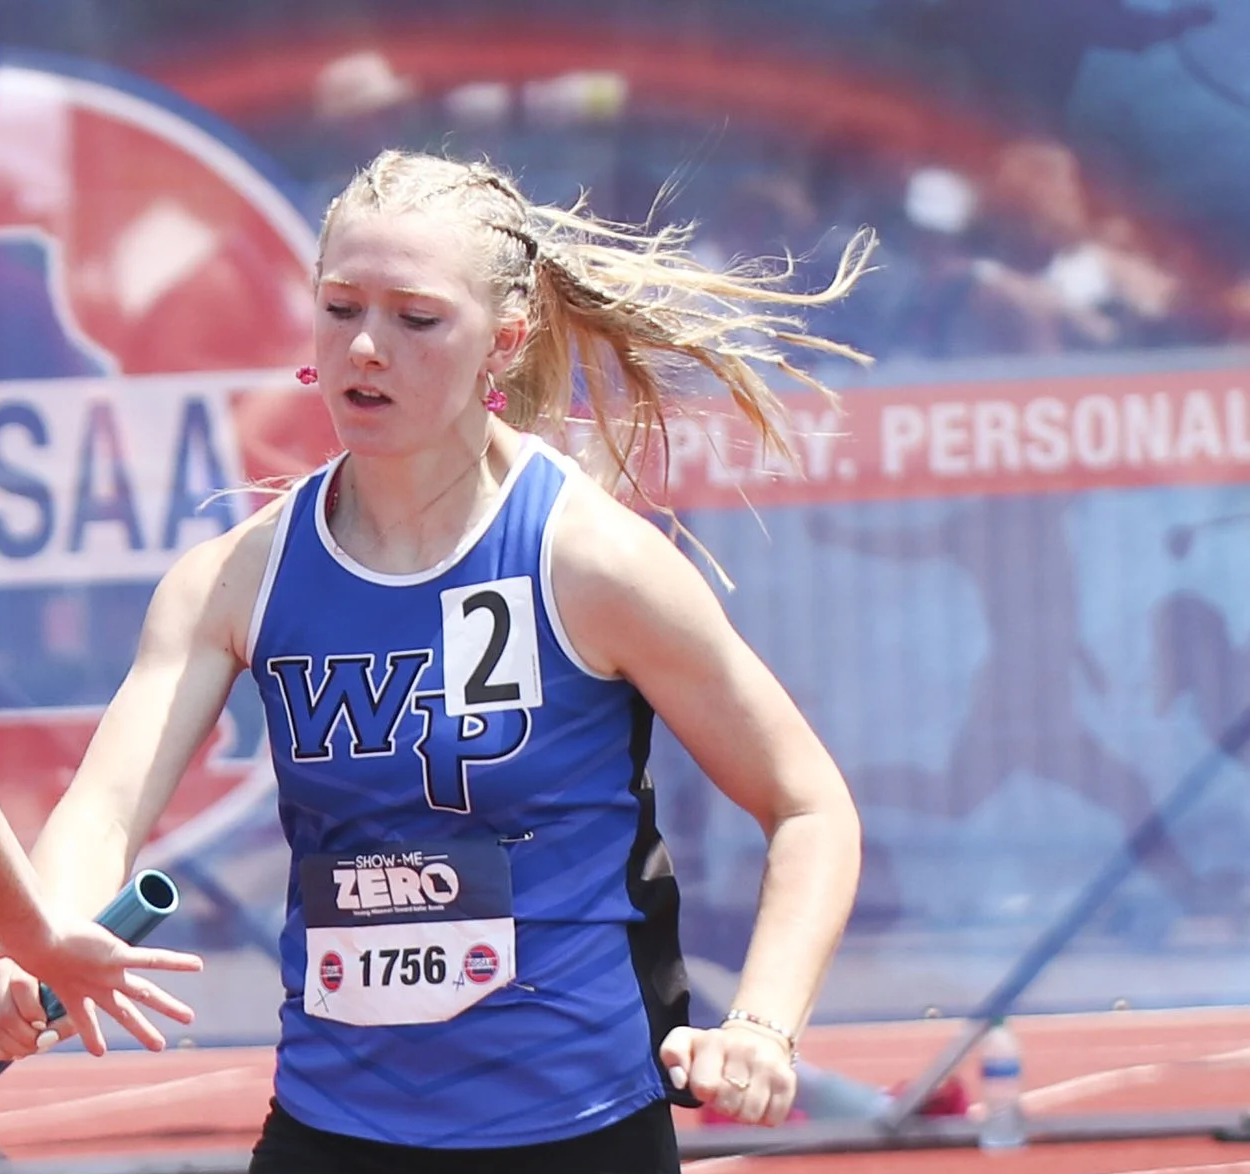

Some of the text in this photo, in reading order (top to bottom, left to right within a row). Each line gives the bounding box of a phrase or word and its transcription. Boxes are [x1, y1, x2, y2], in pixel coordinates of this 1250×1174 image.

[462, 590, 520, 705] 2
[267, 649, 532, 814] WP
[356, 852, 424, 868] SHOW-ME
[333, 863, 458, 910] ZERO
[359, 946, 447, 987] 1756
